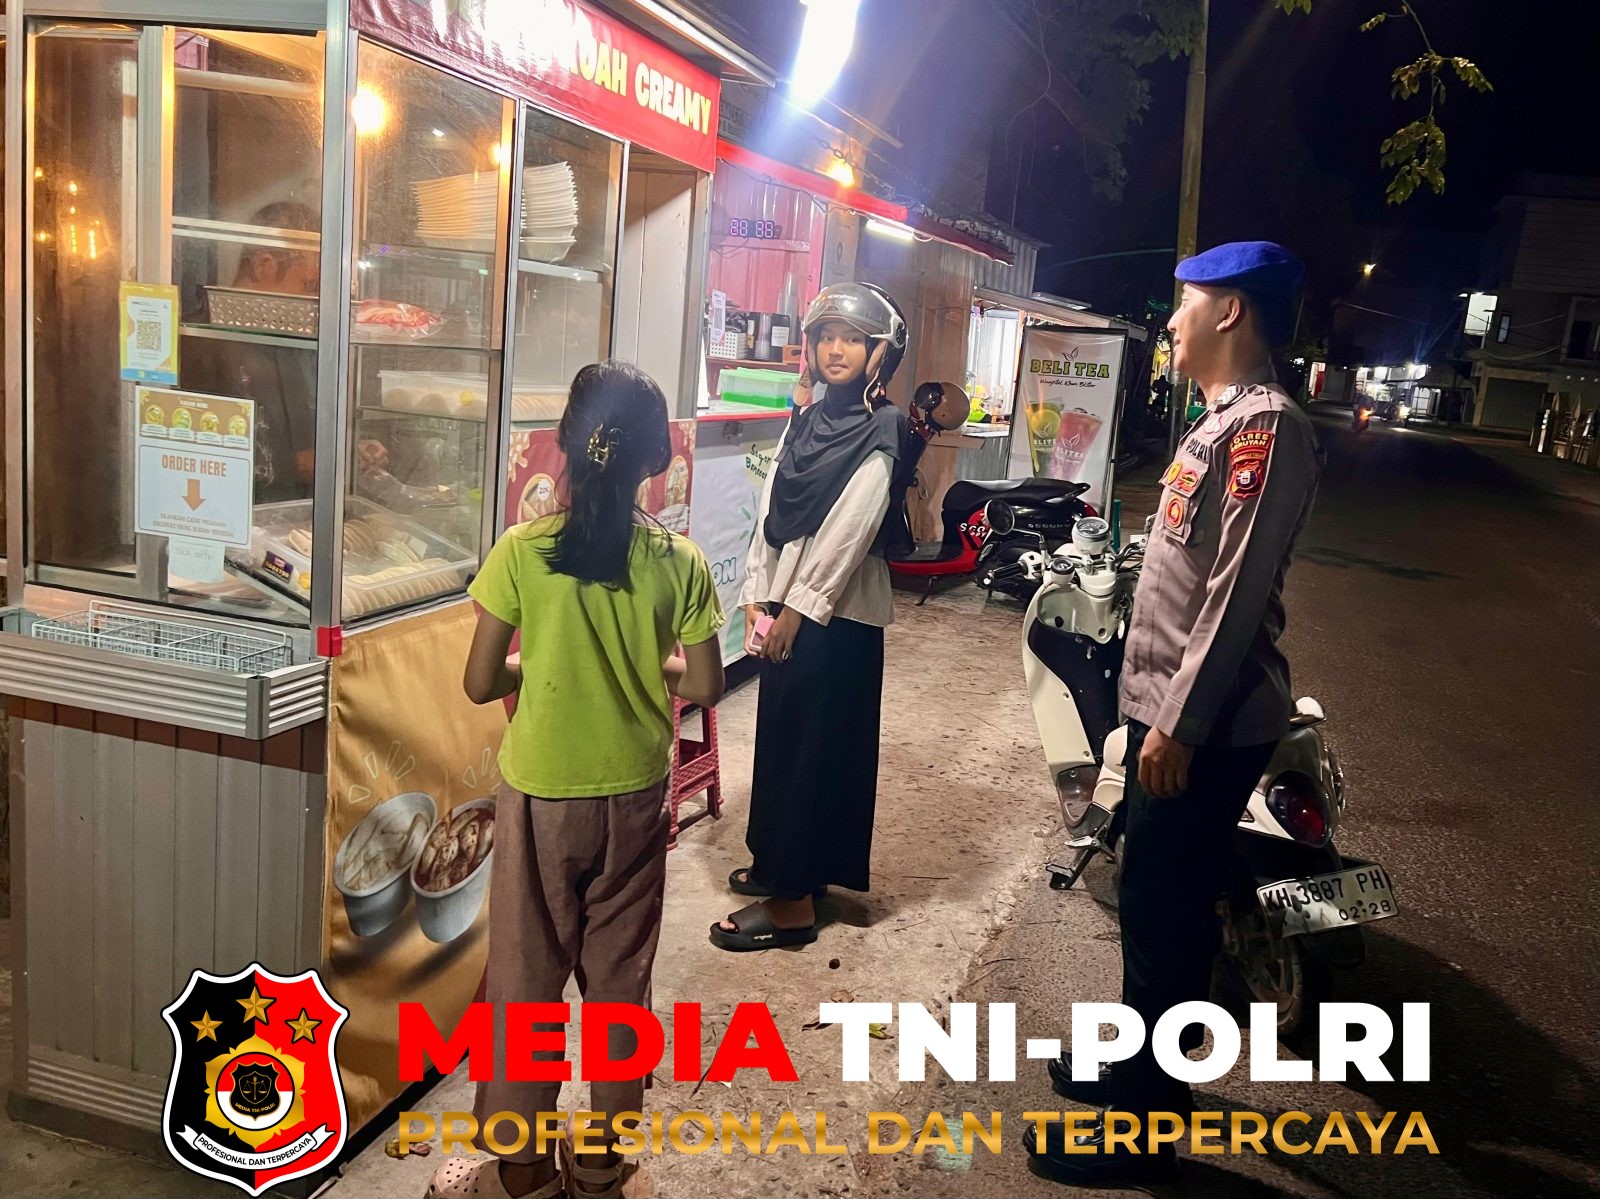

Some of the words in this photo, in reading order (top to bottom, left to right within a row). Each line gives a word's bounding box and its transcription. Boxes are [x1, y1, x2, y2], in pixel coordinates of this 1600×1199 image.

[635, 62, 711, 135] CREAMY
[1030, 358, 1070, 375] BELI
[1075, 362, 1109, 378] TEA
[1186, 437, 1208, 461] POLRI
[161, 454, 196, 473] ORDER
[200, 459, 227, 477] HERE
[710, 557, 737, 587] ON
[1262, 888, 1292, 912] KH
[1296, 878, 1345, 906] 3887
[1355, 869, 1385, 894] PH
